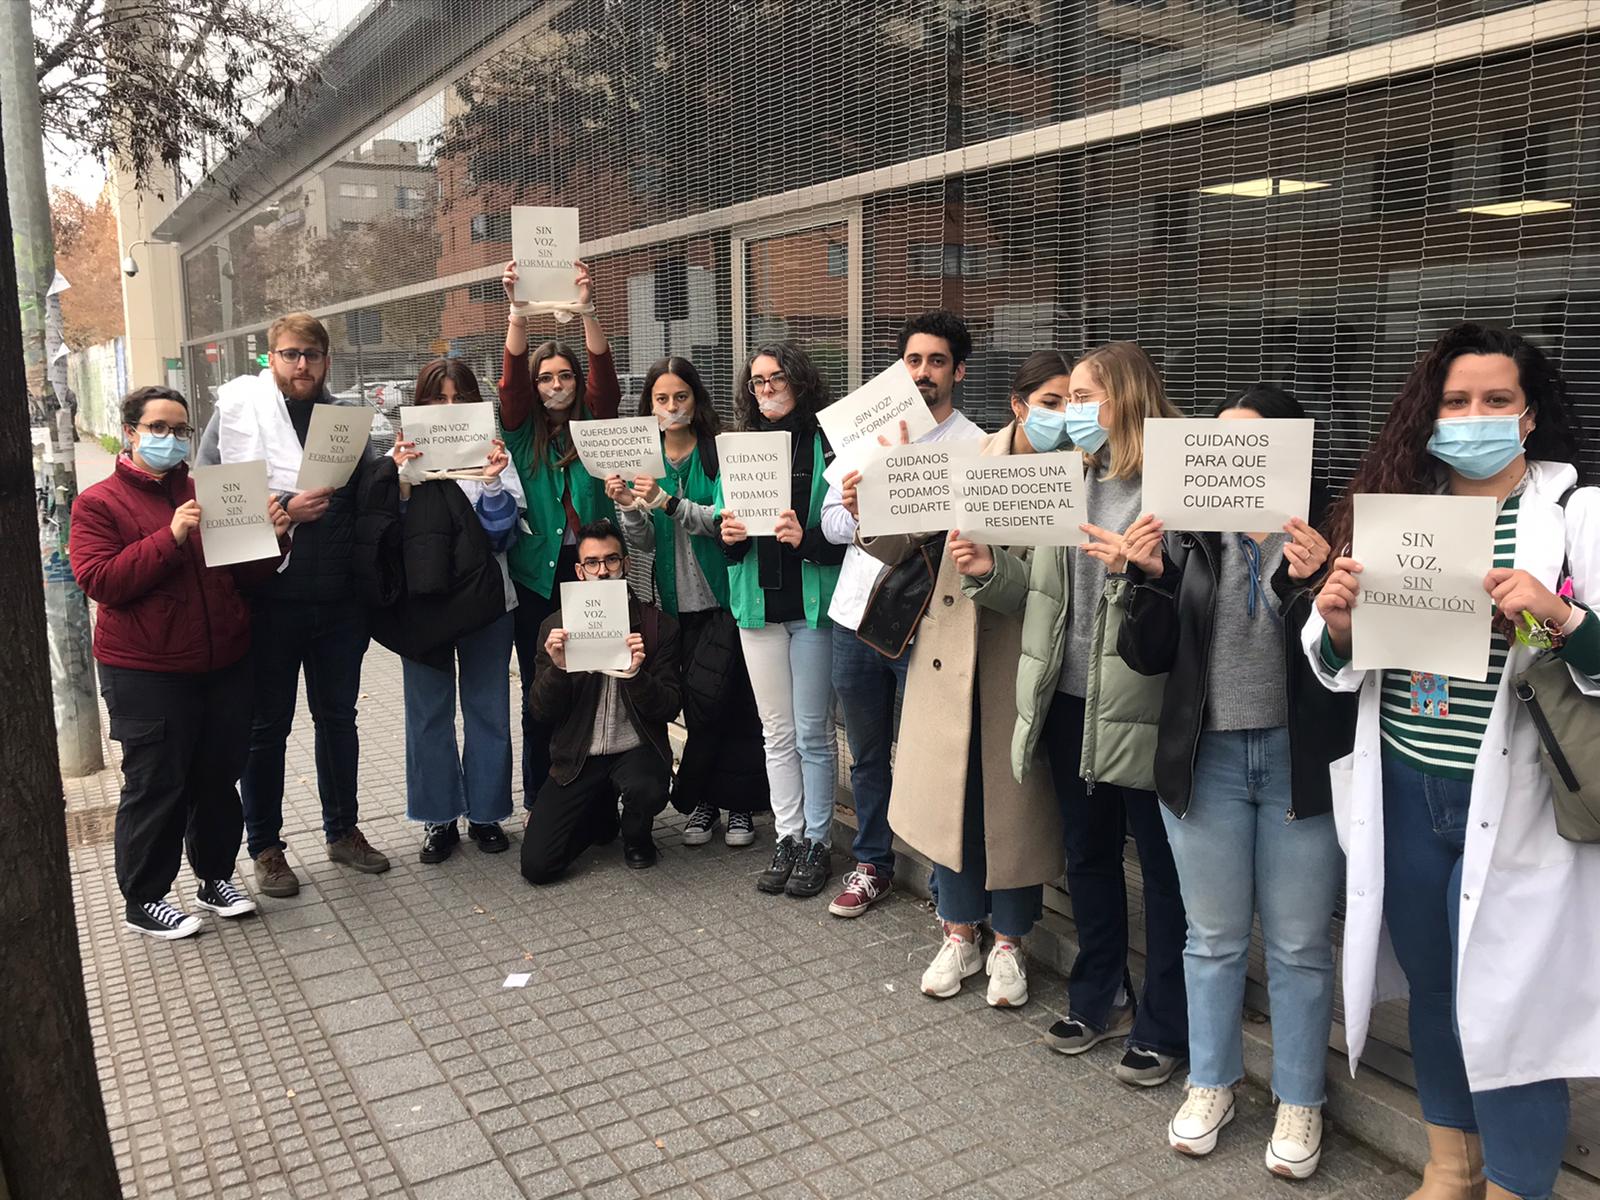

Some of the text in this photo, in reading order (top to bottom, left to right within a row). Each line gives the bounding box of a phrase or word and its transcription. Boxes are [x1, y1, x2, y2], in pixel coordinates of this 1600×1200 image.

[535, 226, 552, 234] SIN
[534, 238, 558, 247] VOZ,
[538, 249, 553, 257] SIN
[854, 395, 893, 427] ¡SIN VOZ!
[333, 424, 350, 433] SIN
[430, 423, 469, 434] ¡SIN VOZ!
[580, 425, 648, 437] QUEREMOS UNA
[580, 436, 653, 448] UNIDAD DOCENTE
[841, 432, 860, 448] ¡SIN
[1184, 434, 1269, 447] CUIDANOS
[330, 446, 345, 454] SIN
[582, 447, 654, 458] QUE DEFIENDA AL
[596, 459, 642, 469] RESIDENTE
[726, 453, 779, 463] CUÍDANOS
[886, 453, 949, 468] CUIDANOS
[1185, 454, 1267, 468] PARA QUE
[729, 471, 778, 482] PARA QUE
[888, 469, 949, 484] PARA QUE
[966, 465, 1067, 480] QUEREMOS UNA
[222, 483, 240, 492] SIN
[1184, 475, 1266, 488] PODAMOS
[730, 490, 779, 499] PODAMOS
[889, 484, 950, 499] PODAMOS
[963, 481, 1073, 496] UNIDAD DOCENTE
[221, 495, 247, 504] VOZ,
[964, 498, 1075, 513] QUE DEFIENDA AL
[1183, 495, 1265, 509] CUIDARTE
[226, 506, 242, 516] SIN
[890, 500, 951, 515] CUIDARTE
[206, 513, 266, 528] FORMACIÓN
[985, 515, 1055, 527] RESIDENTE
[1401, 532, 1435, 548] SIN
[1396, 554, 1442, 574] VOZ,
[1402, 575, 1433, 591] SIN
[585, 600, 601, 608] SIN
[1363, 590, 1476, 614] FORMACIÓN
[584, 610, 607, 618] VOZ,
[588, 621, 603, 629] SIN
